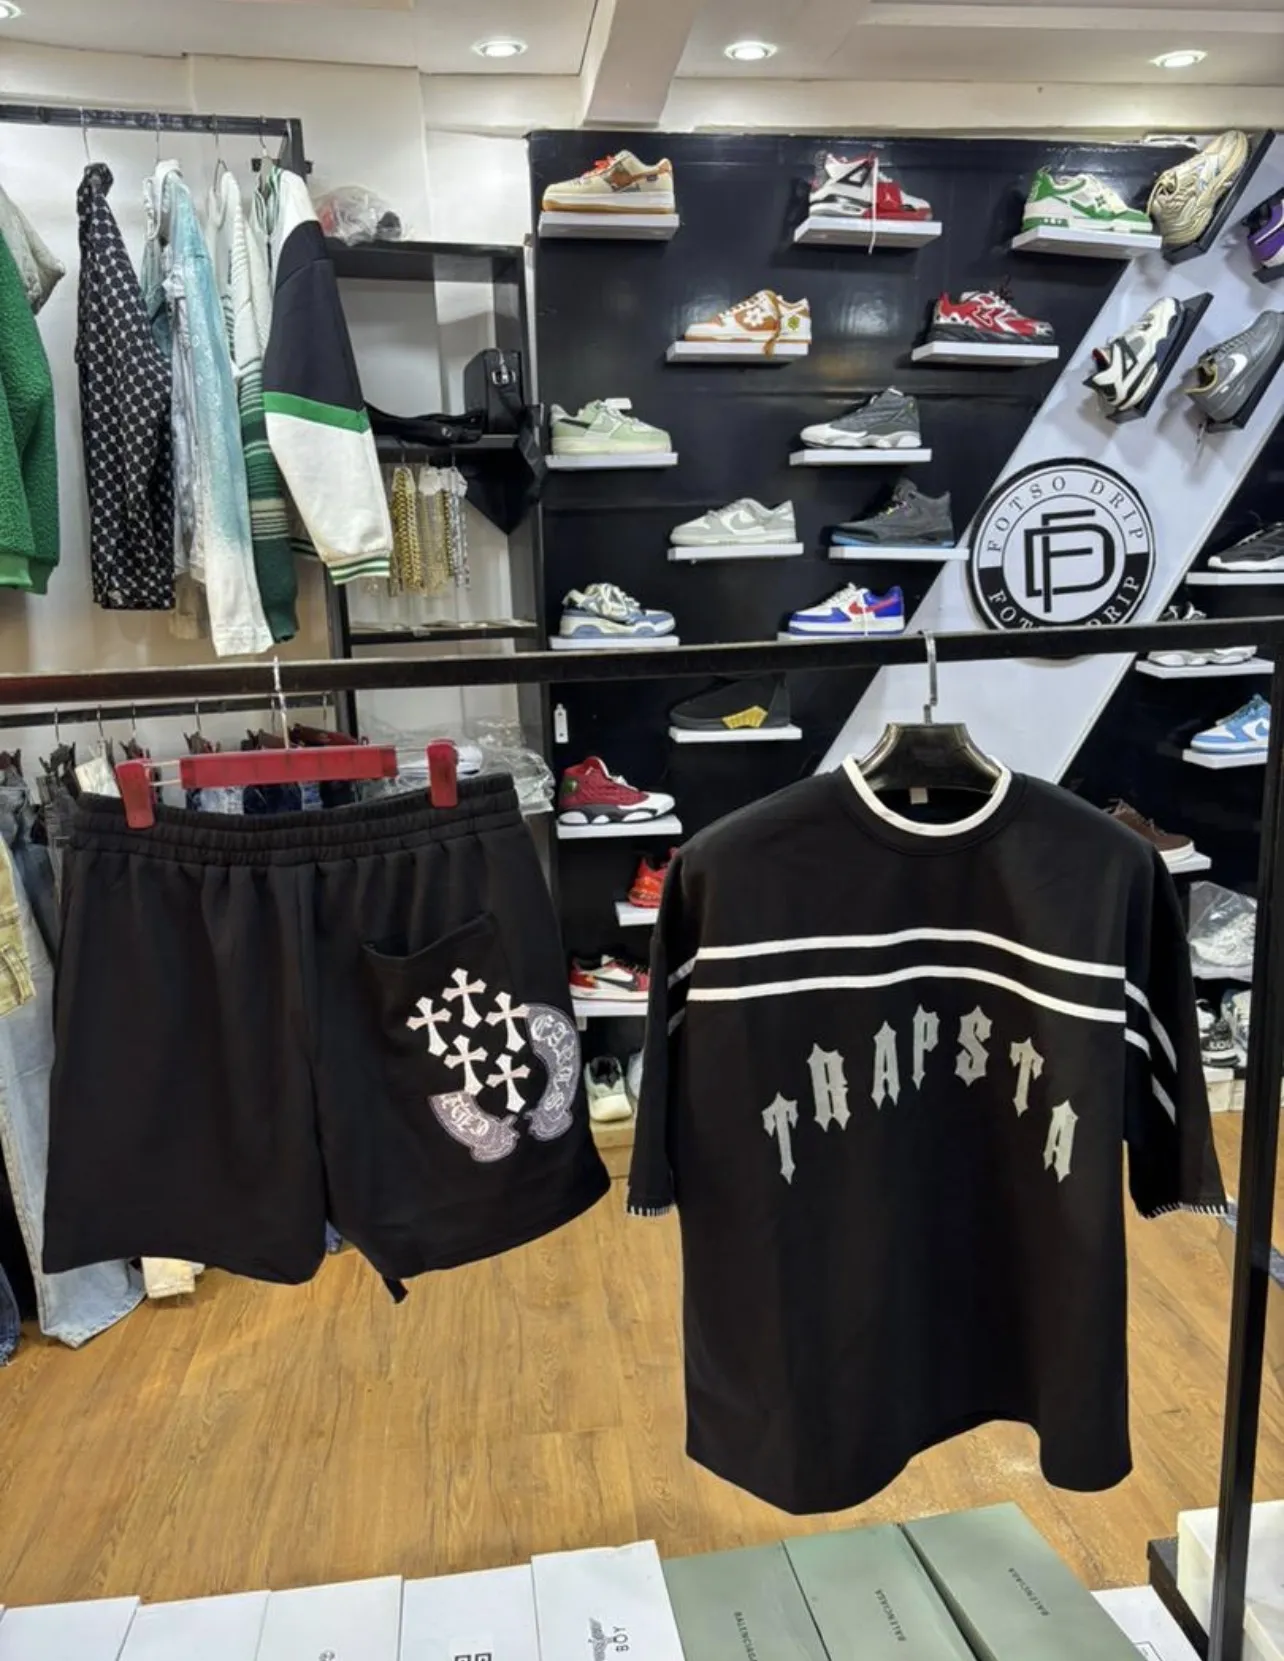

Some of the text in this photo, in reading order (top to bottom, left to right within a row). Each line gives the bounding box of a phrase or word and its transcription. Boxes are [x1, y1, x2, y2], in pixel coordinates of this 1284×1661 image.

[987, 476, 1144, 552] FOTSO DRIP
[761, 1003, 1079, 1184] TRAPSTA
[612, 1625, 630, 1653] BOY
[733, 1611, 758, 1661] BALENCIAG
